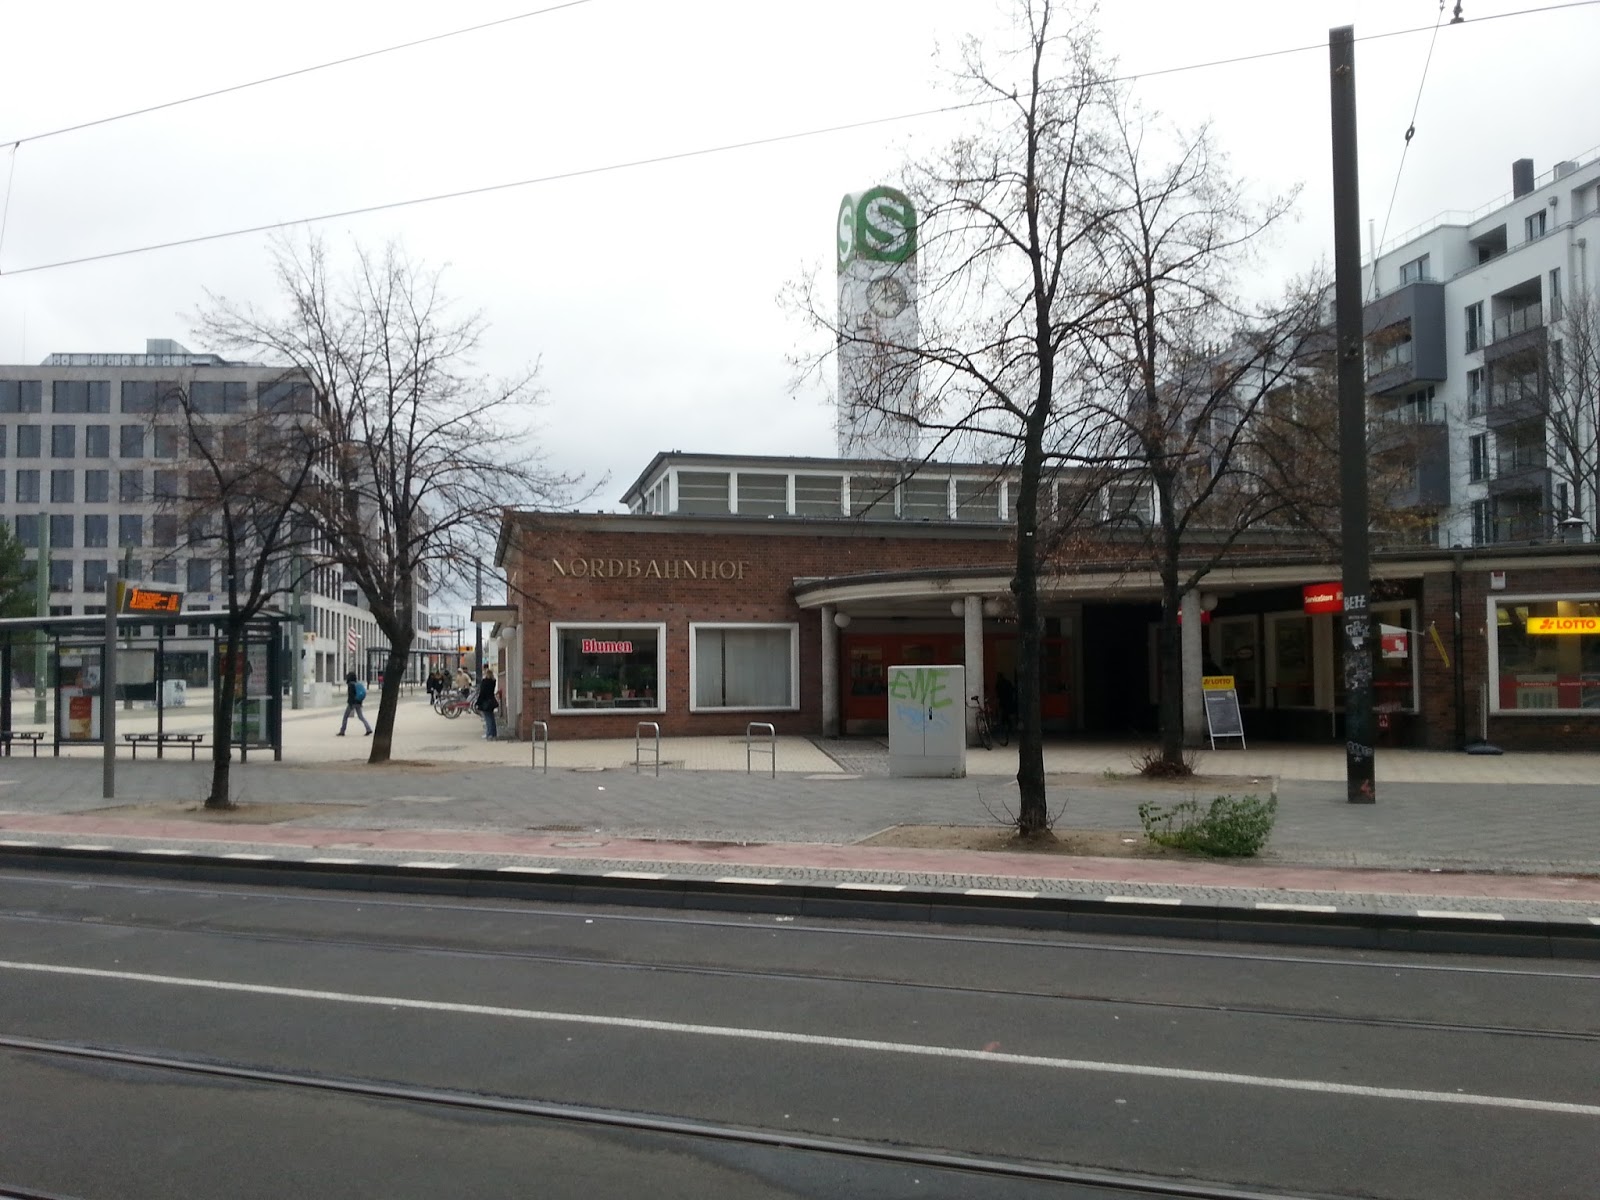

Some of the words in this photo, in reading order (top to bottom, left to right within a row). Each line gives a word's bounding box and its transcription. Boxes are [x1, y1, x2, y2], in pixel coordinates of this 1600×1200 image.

[866, 197, 907, 253] S
[552, 558, 750, 580] NORDBAHNHOF
[1556, 620, 1596, 629] LOTTO
[581, 638, 633, 654] Blumen
